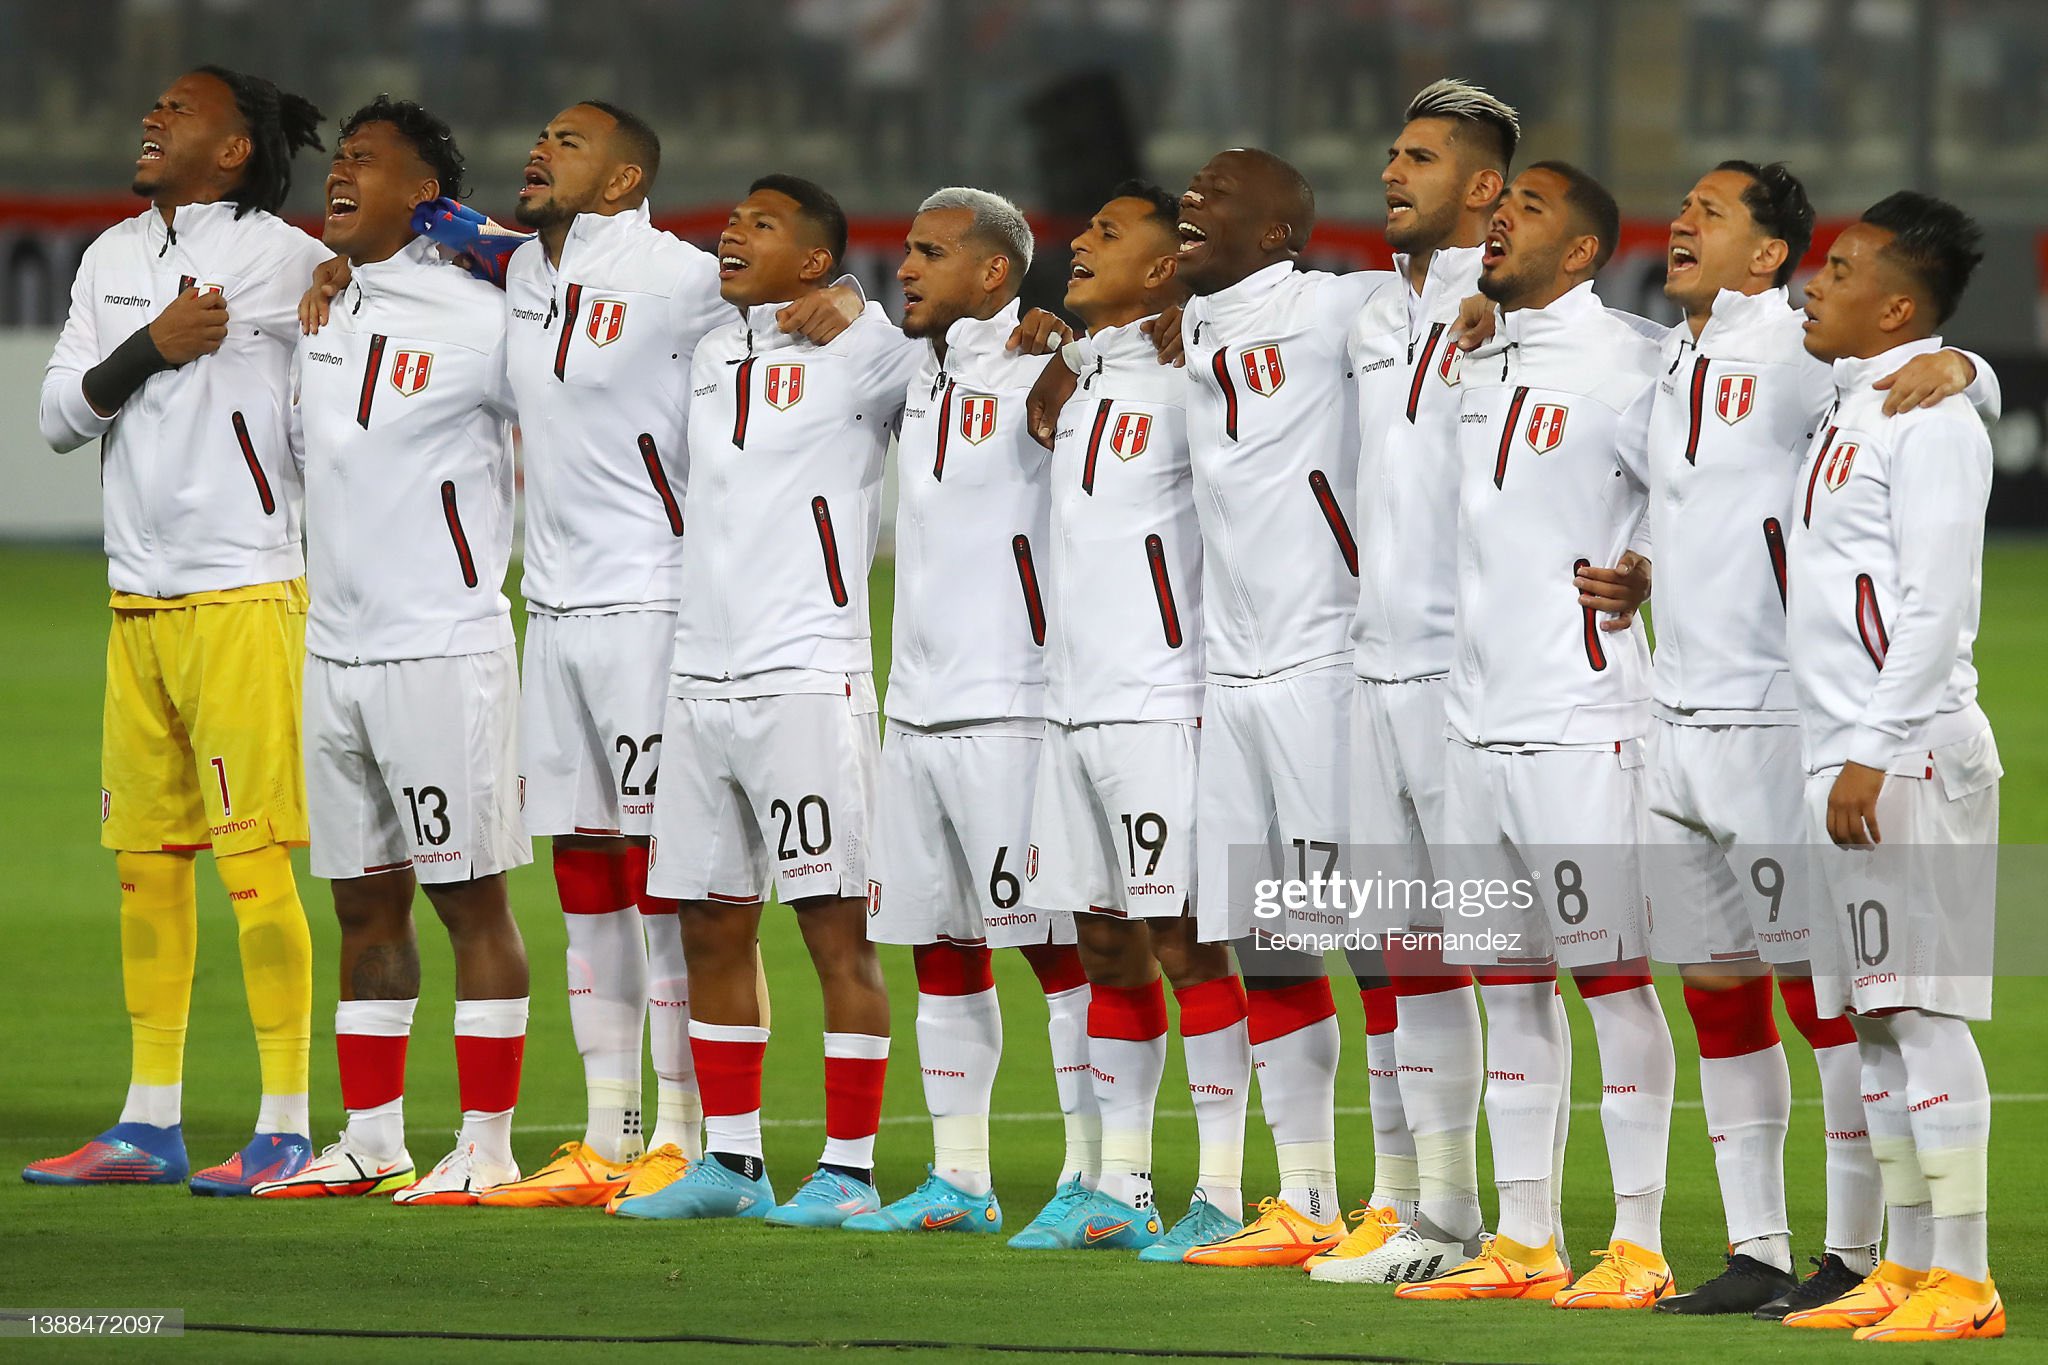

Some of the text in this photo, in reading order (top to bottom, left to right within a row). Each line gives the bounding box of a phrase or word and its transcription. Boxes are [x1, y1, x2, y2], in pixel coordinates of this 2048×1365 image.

[104, 293, 151, 308] marathon
[512, 307, 544, 322] marathon
[308, 351, 344, 366] marathon
[1361, 357, 1395, 375] marathon
[211, 757, 231, 816] 1
[403, 786, 451, 846] 13
[770, 794, 832, 861] 20
[413, 851, 462, 864] marathon
[1121, 812, 1168, 878] 19
[782, 862, 833, 880] marathon
[990, 846, 1021, 909] 6
[1292, 838, 1339, 902] 17
[1554, 860, 1589, 925] 8
[1750, 857, 1785, 923] 9
[984, 912, 1037, 928] marathon
[1288, 908, 1344, 925] marathon
[1758, 927, 1811, 944] marathon
[1847, 900, 1889, 970] 10
